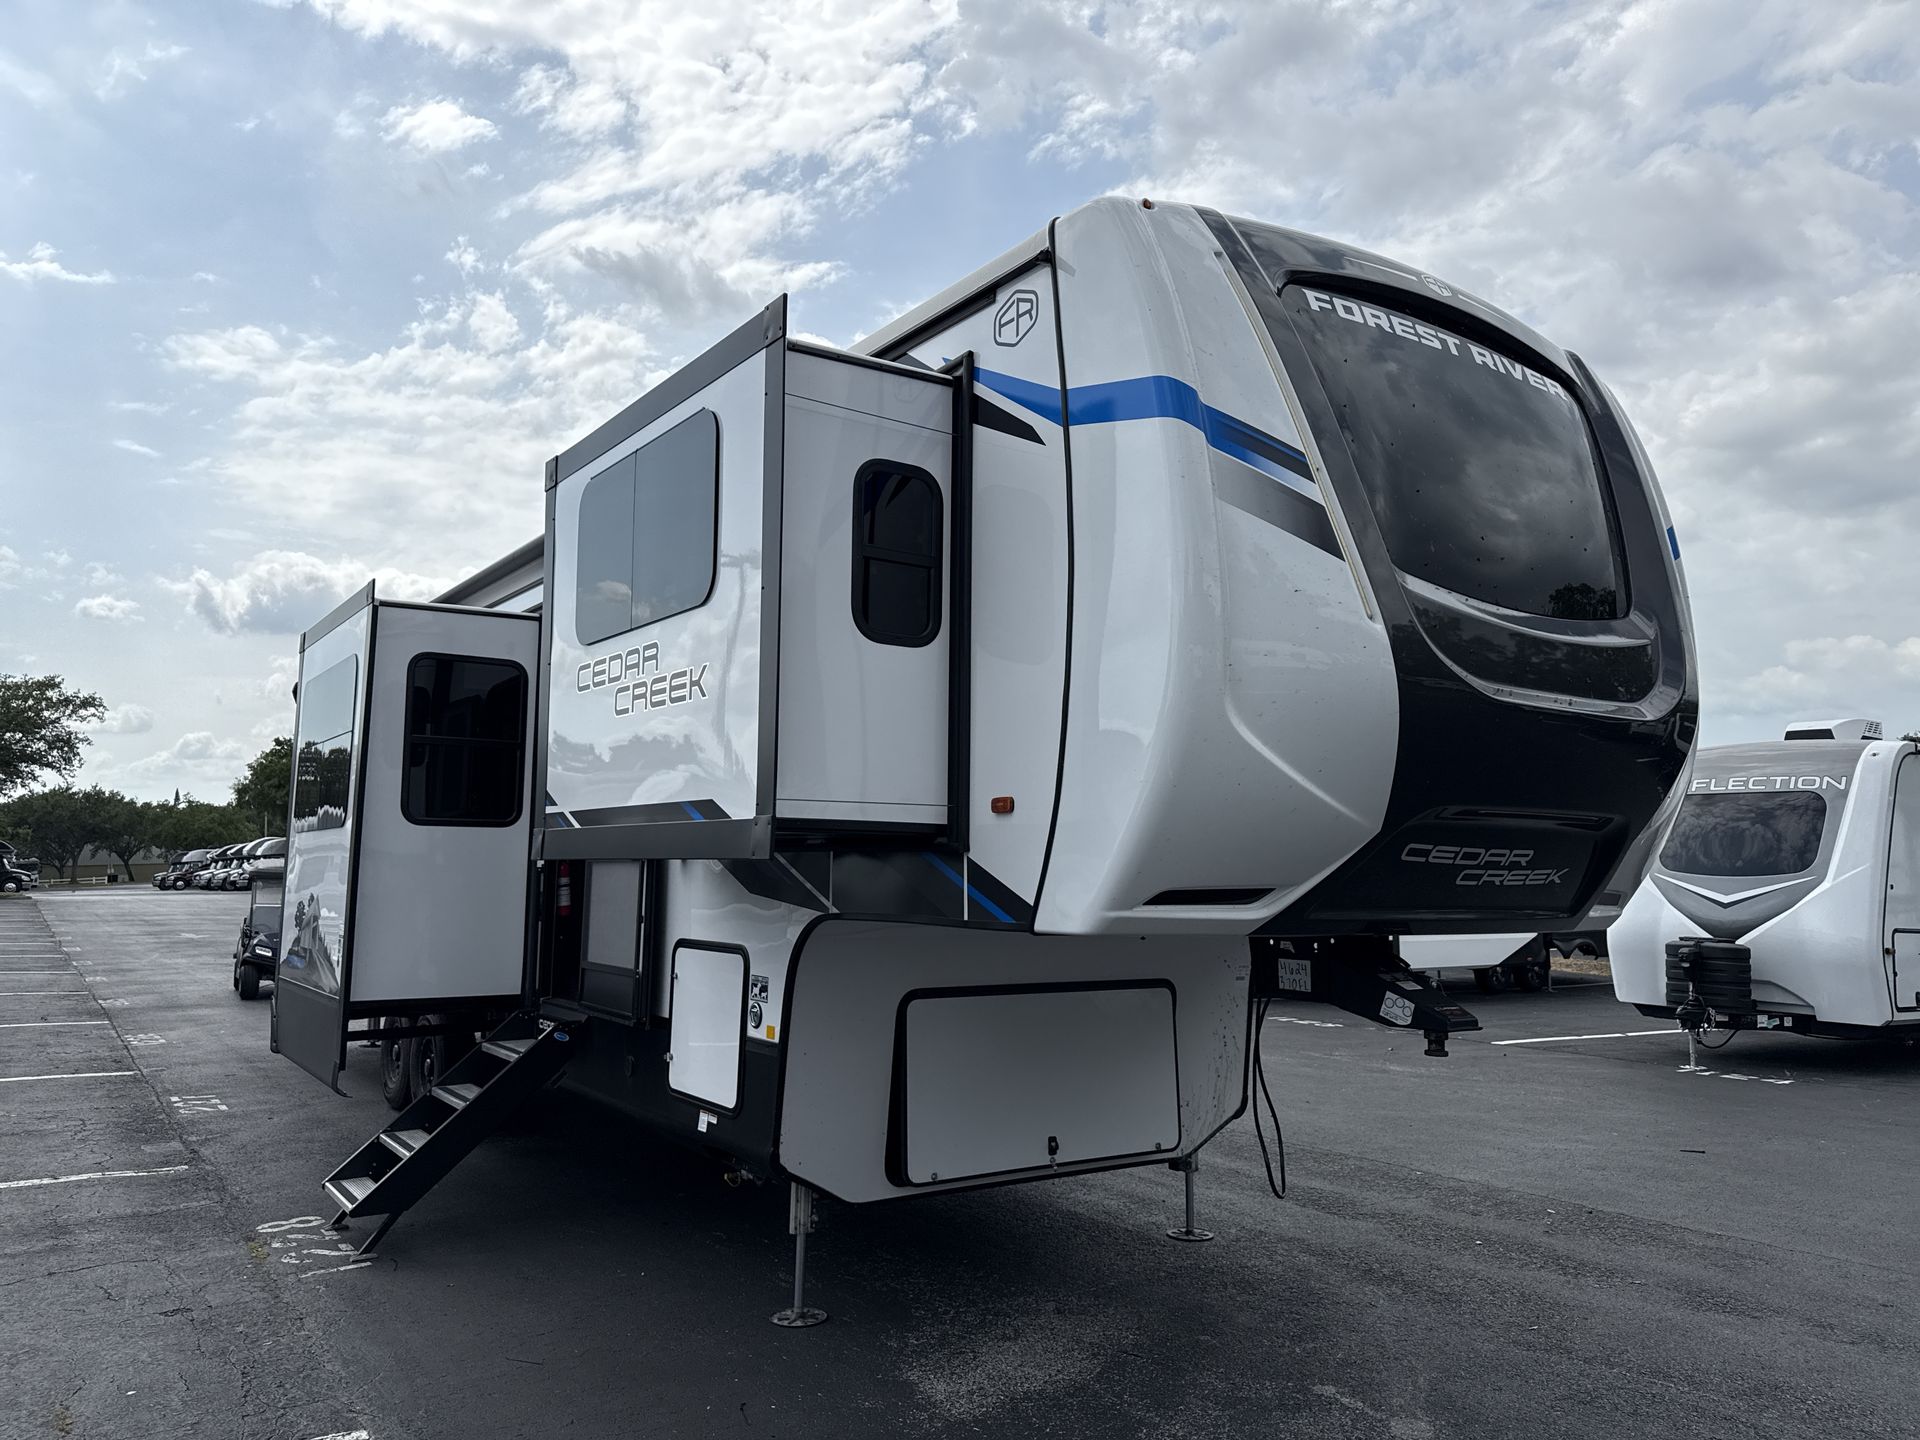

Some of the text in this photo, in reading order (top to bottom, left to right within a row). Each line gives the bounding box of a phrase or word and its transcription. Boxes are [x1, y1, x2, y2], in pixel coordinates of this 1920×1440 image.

[1302, 288, 1569, 401] FOREST RIVER
[576, 639, 660, 694] CEDAR
[614, 662, 710, 718] CREEK
[1688, 775, 1848, 793] FLECTION
[1401, 843, 1535, 867] CEDAR
[1456, 867, 1570, 886] CREEK
